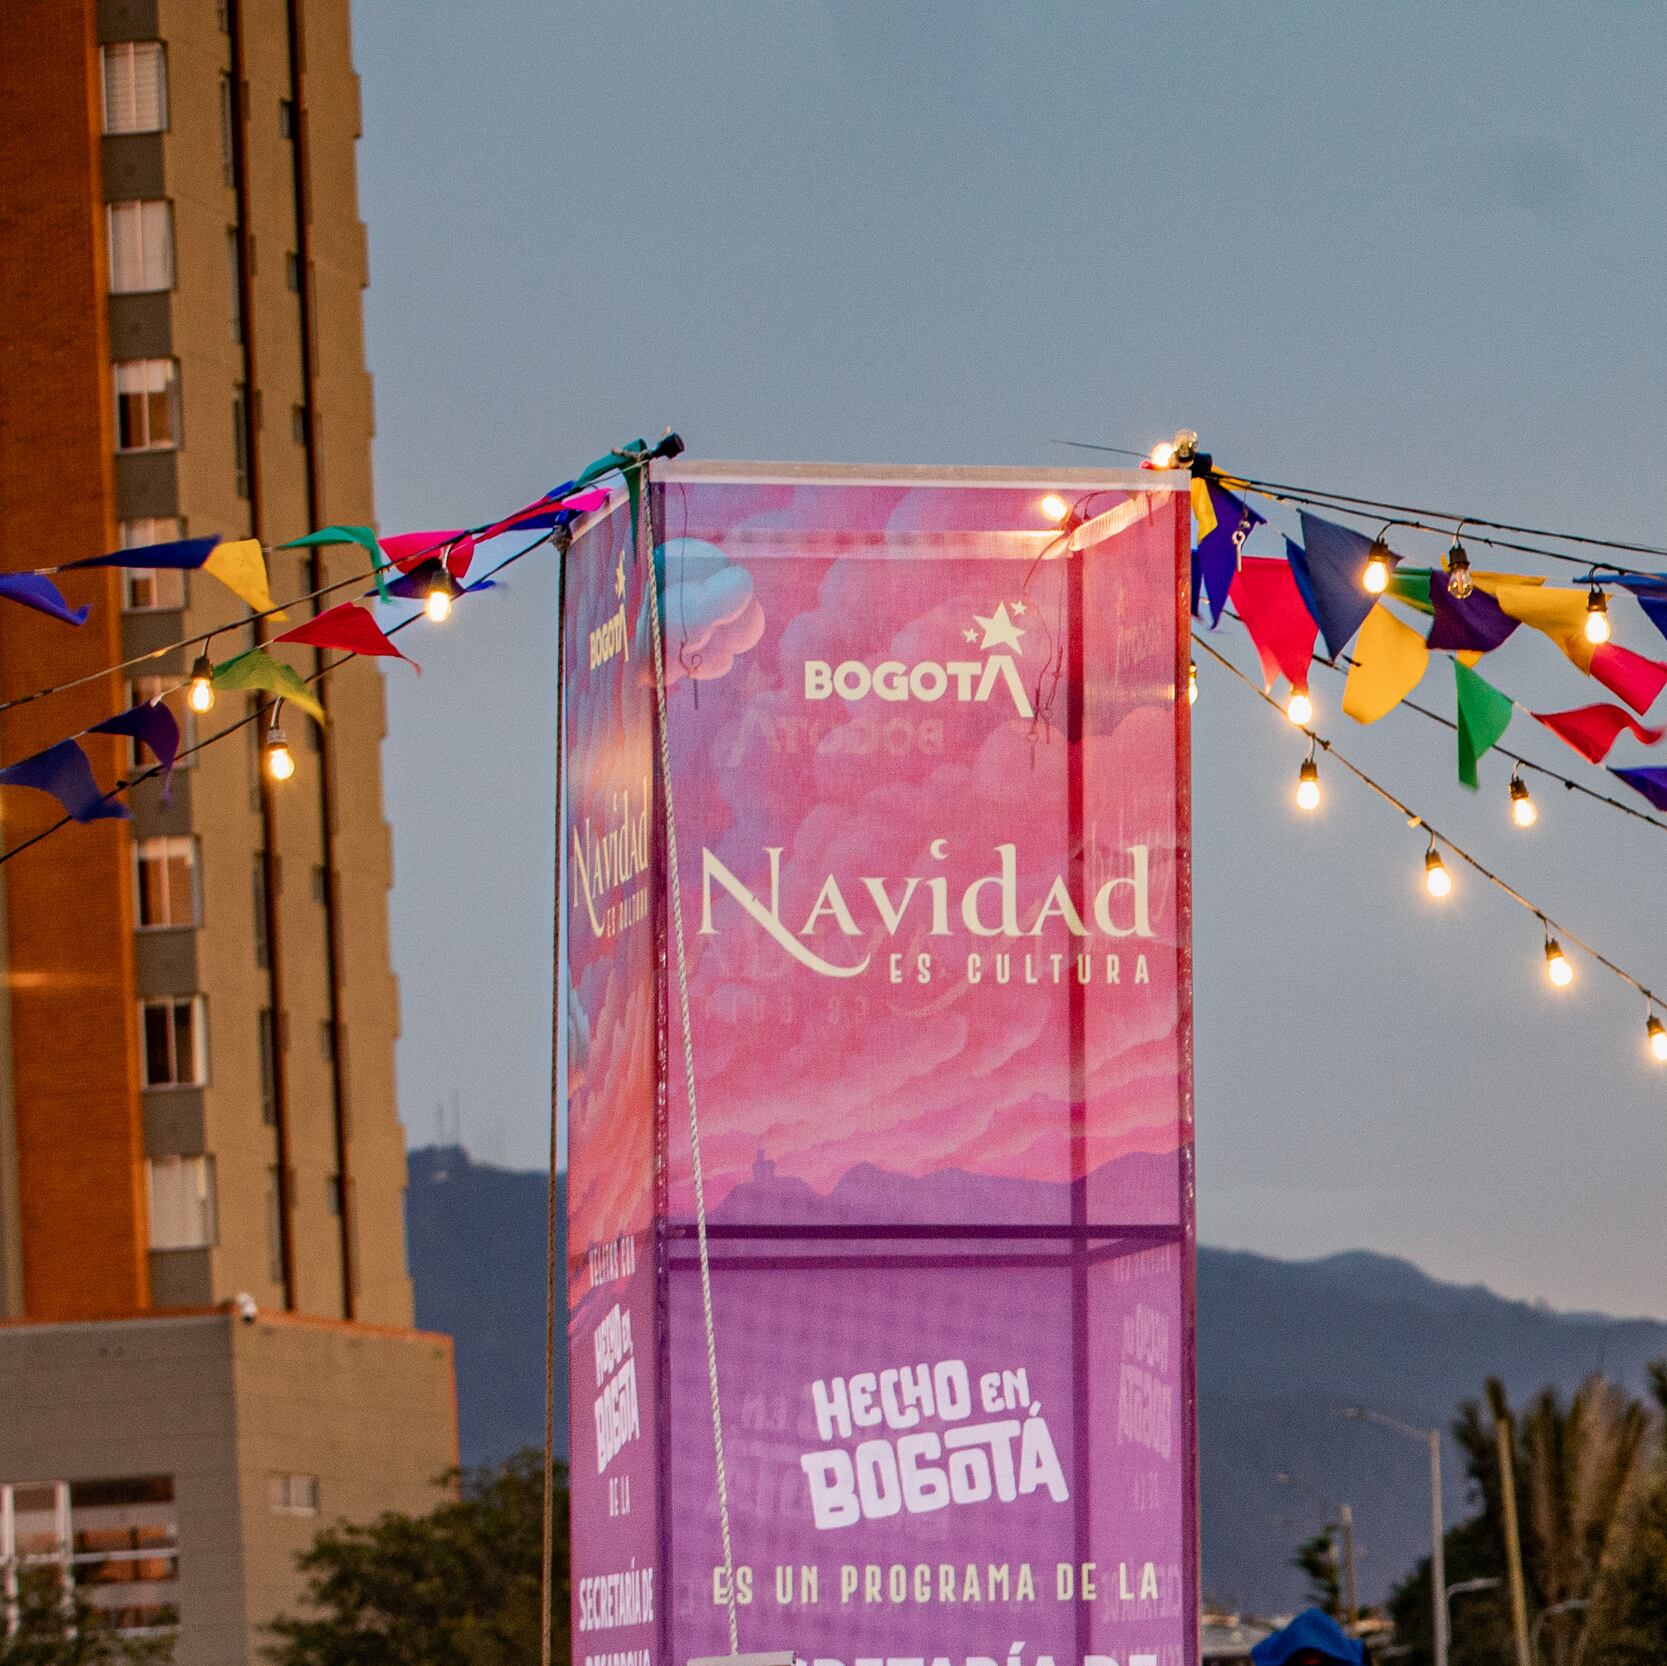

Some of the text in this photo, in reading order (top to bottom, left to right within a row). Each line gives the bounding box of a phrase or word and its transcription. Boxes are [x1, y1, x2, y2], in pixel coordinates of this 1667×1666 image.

[890, 953, 1150, 984] ES CULTURA
[812, 1360, 972, 1441] HECHO
[713, 1562, 1159, 1605] ES UN PROGRAMA DE LA
